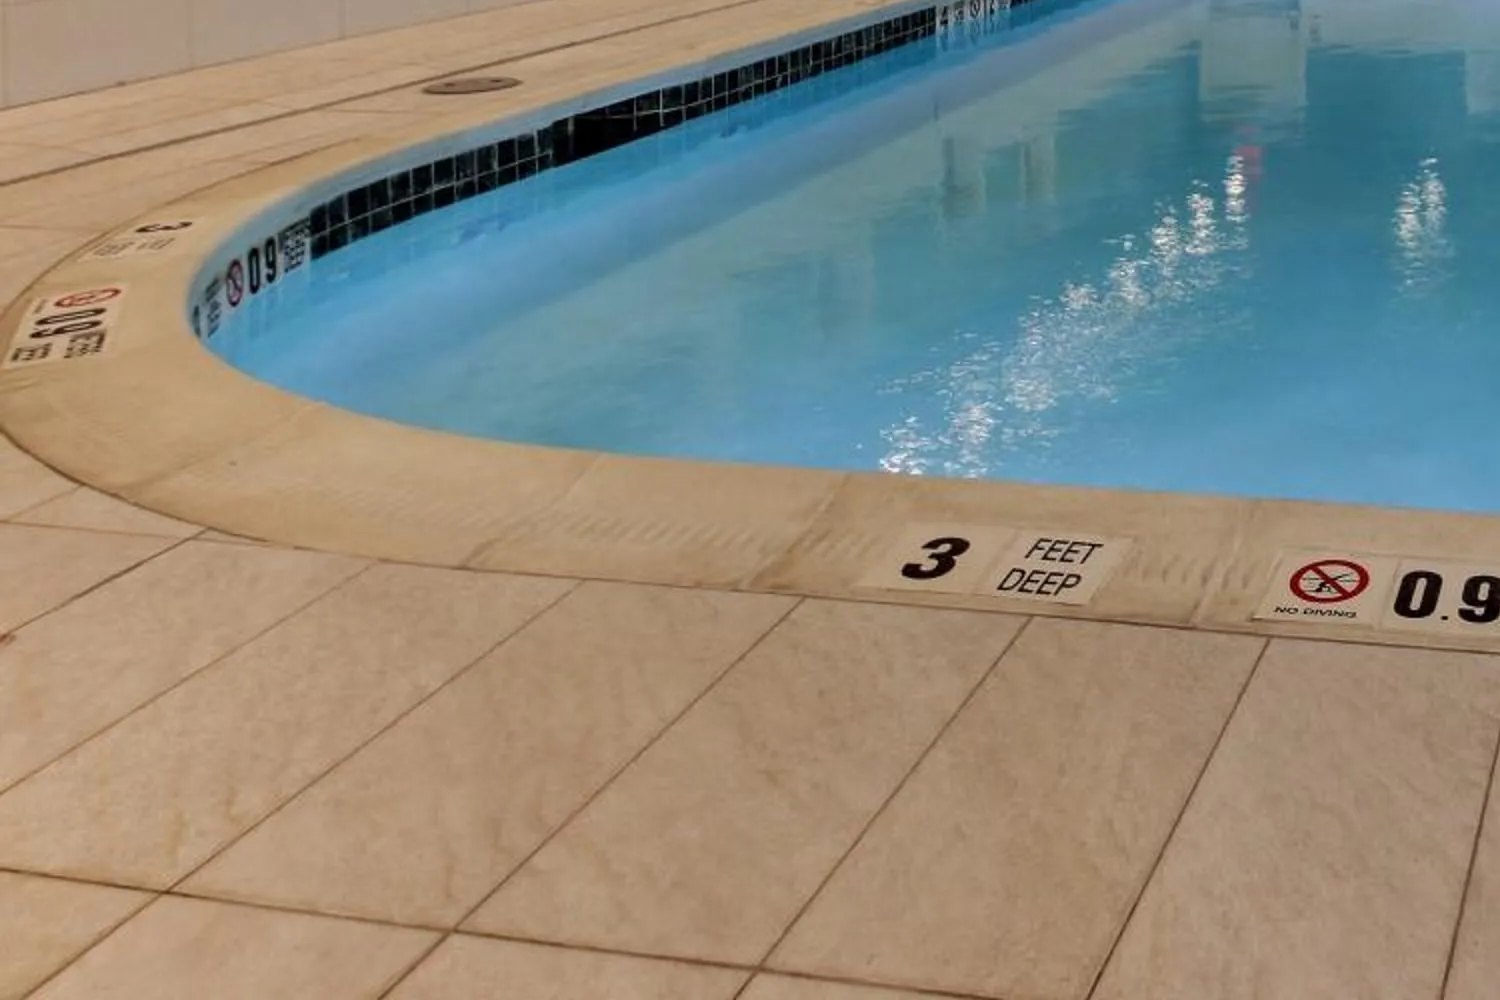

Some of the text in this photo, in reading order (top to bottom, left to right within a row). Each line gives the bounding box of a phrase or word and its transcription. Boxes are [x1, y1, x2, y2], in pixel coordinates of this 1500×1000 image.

[902, 537, 1104, 580] 3 FEET
[997, 568, 1082, 597] DEEP
[1274, 606, 1357, 618] NO DIVING
